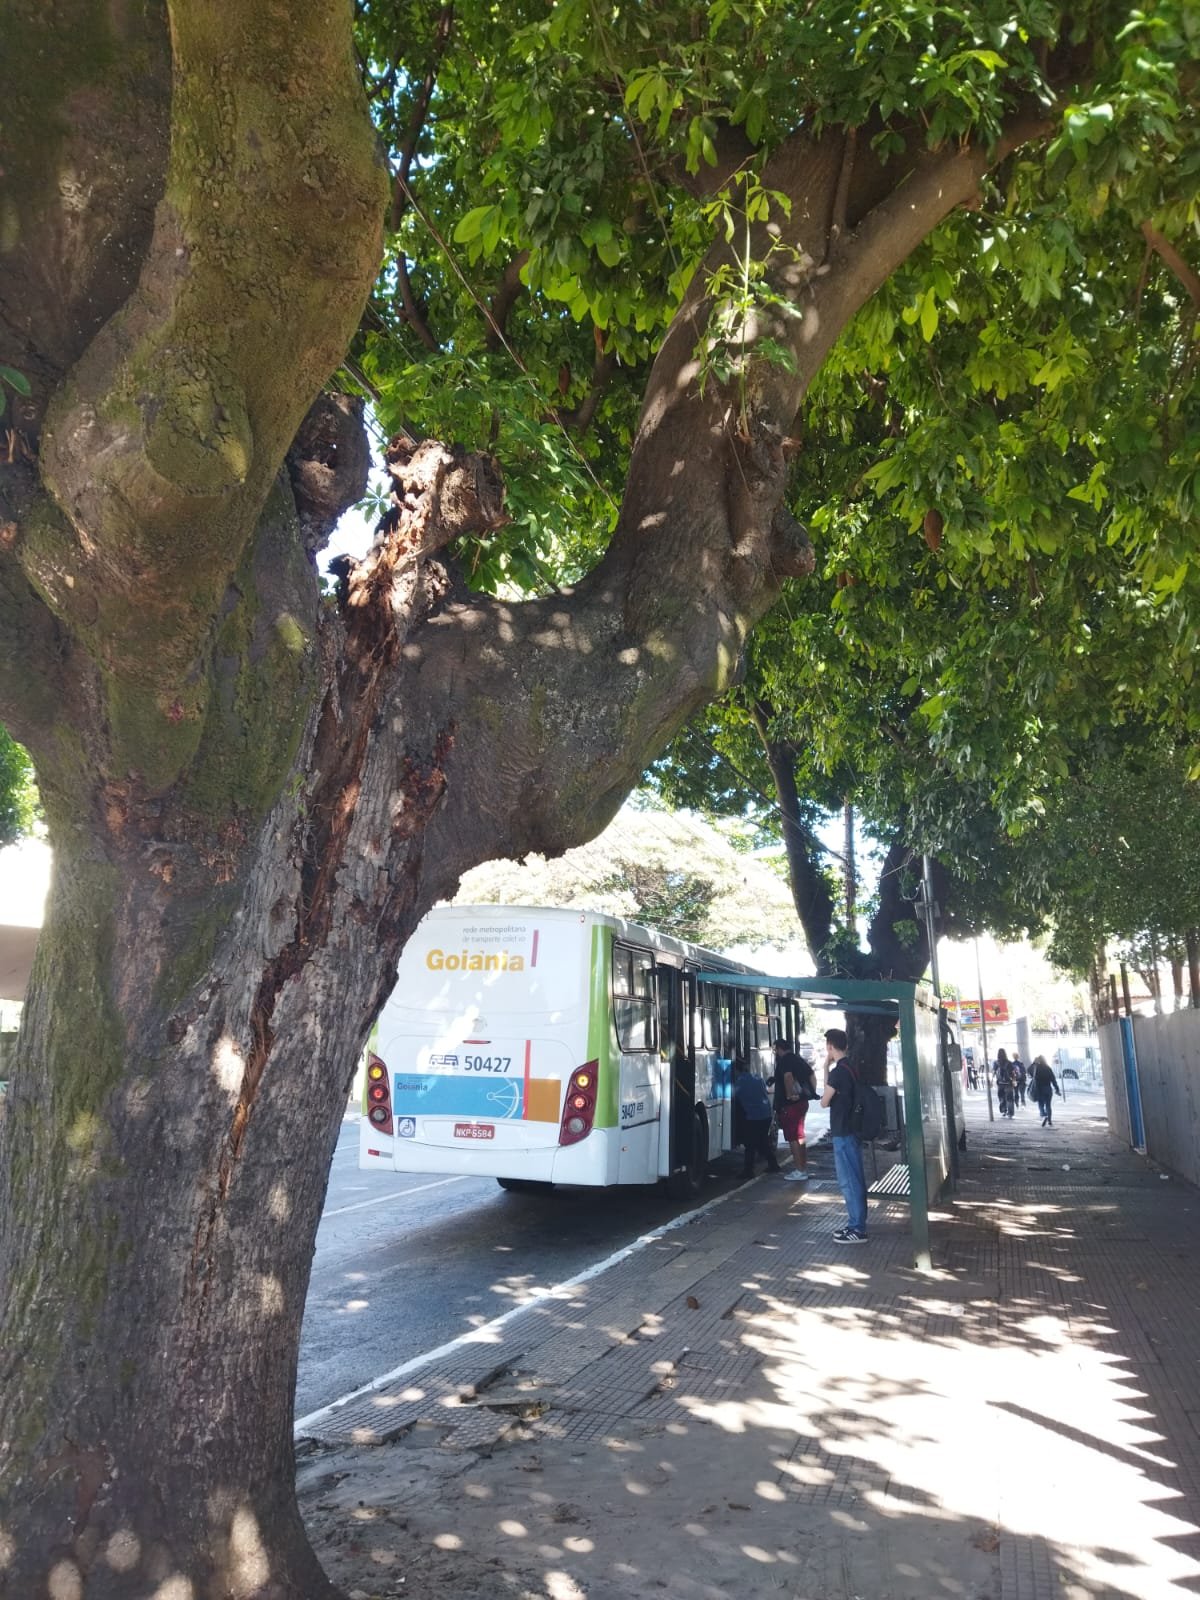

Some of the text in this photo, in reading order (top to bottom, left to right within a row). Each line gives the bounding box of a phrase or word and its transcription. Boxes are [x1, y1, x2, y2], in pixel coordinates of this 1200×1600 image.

[462, 924, 526, 935] rede metropolitana
[464, 1055, 512, 1073] 50427
